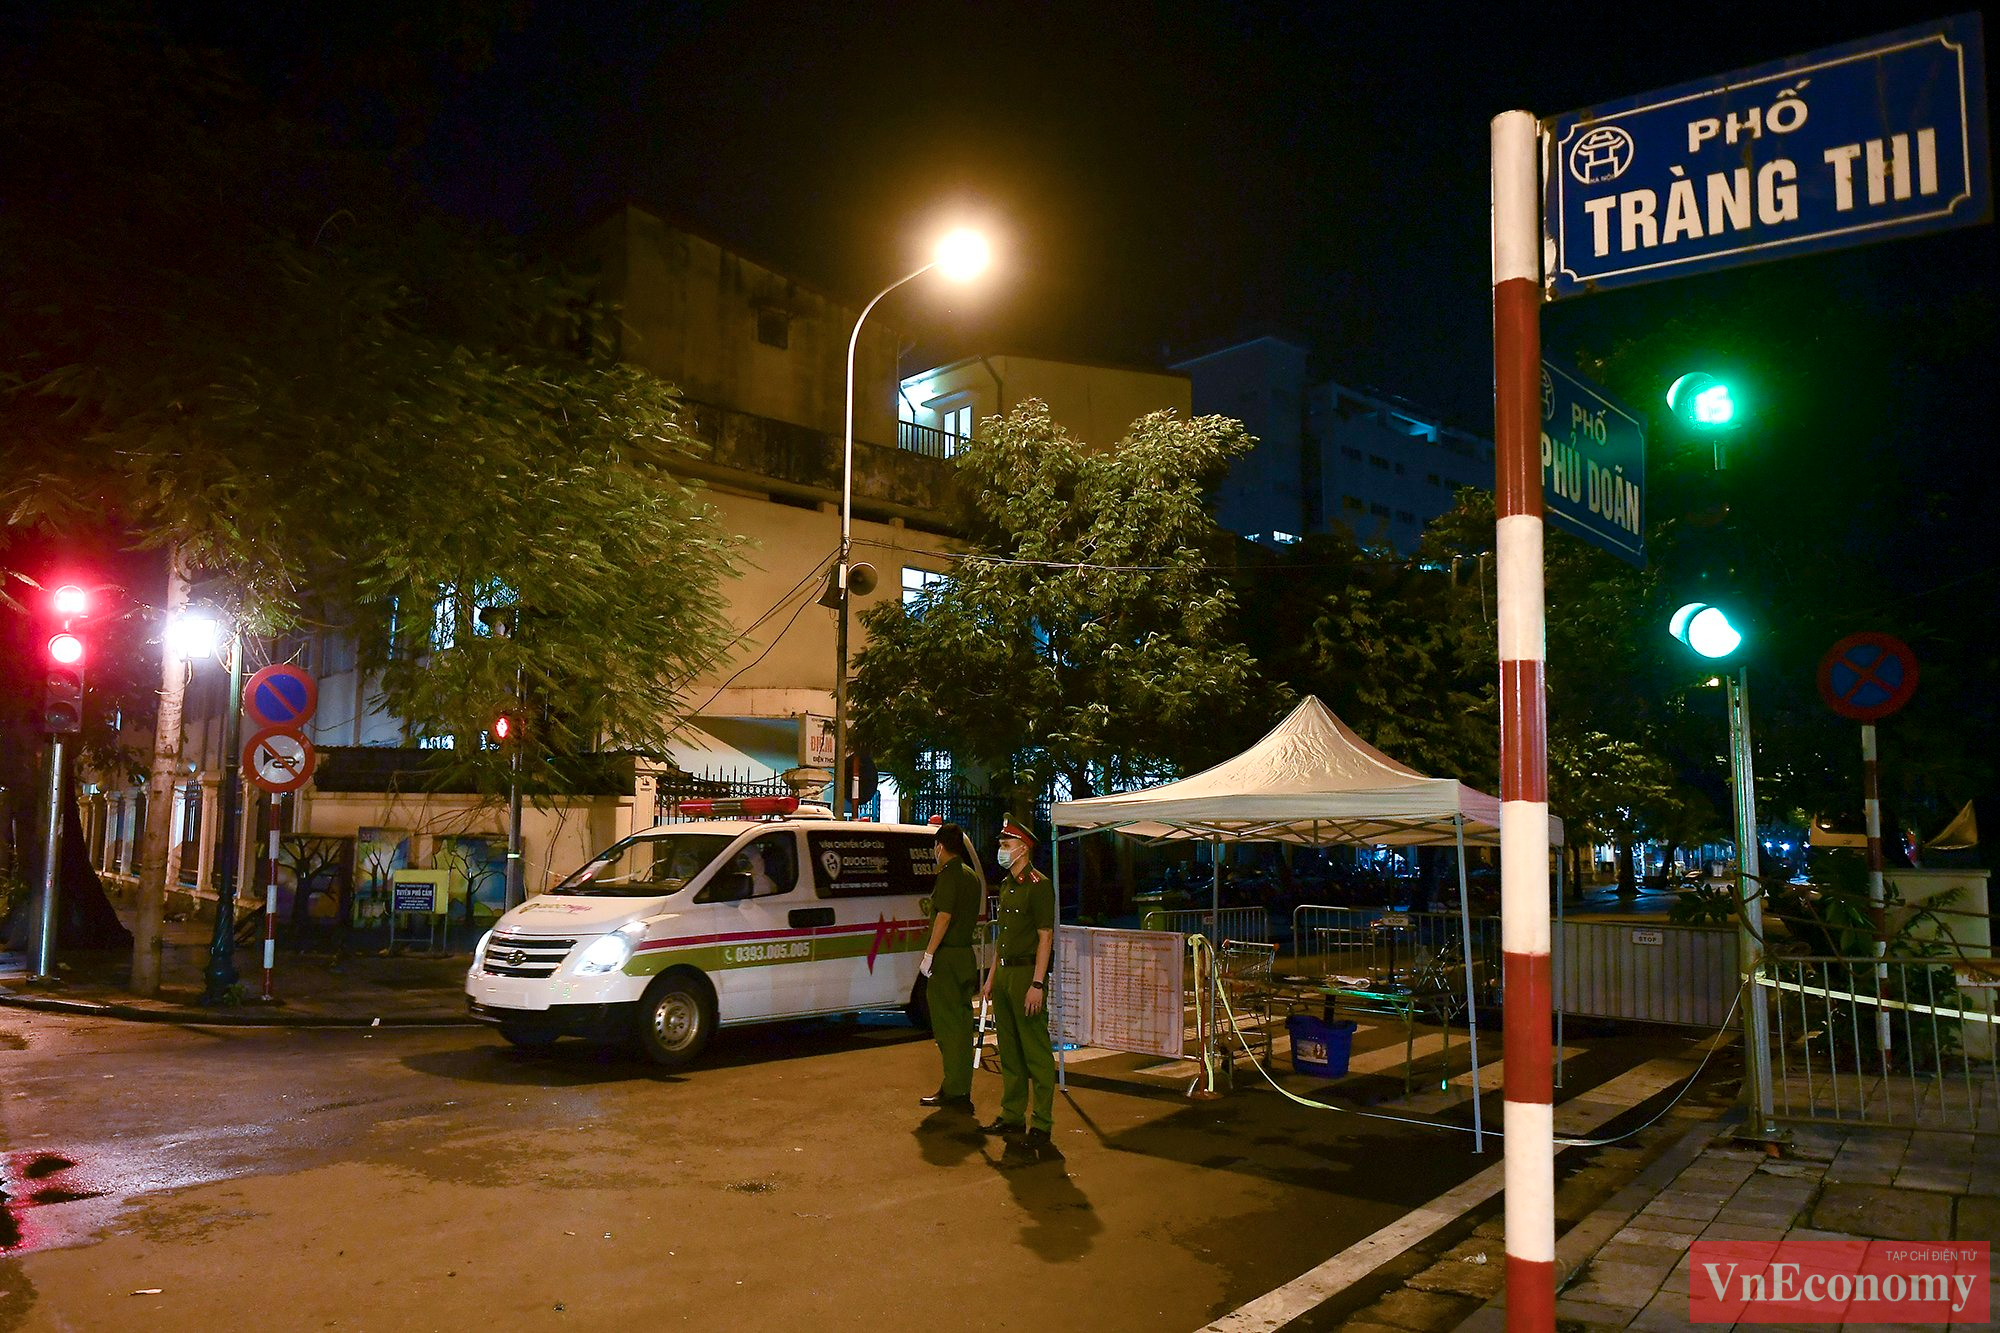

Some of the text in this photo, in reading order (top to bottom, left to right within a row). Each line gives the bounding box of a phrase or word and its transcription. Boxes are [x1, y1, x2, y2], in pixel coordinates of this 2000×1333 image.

[1687, 80, 1811, 153] PHỐ
[1585, 127, 1938, 258] TRÀNG THI
[1571, 402, 1607, 446] PHỐ
[1587, 464, 1640, 535] DOÃN
[735, 942, 810, 962] 0393.005.005
